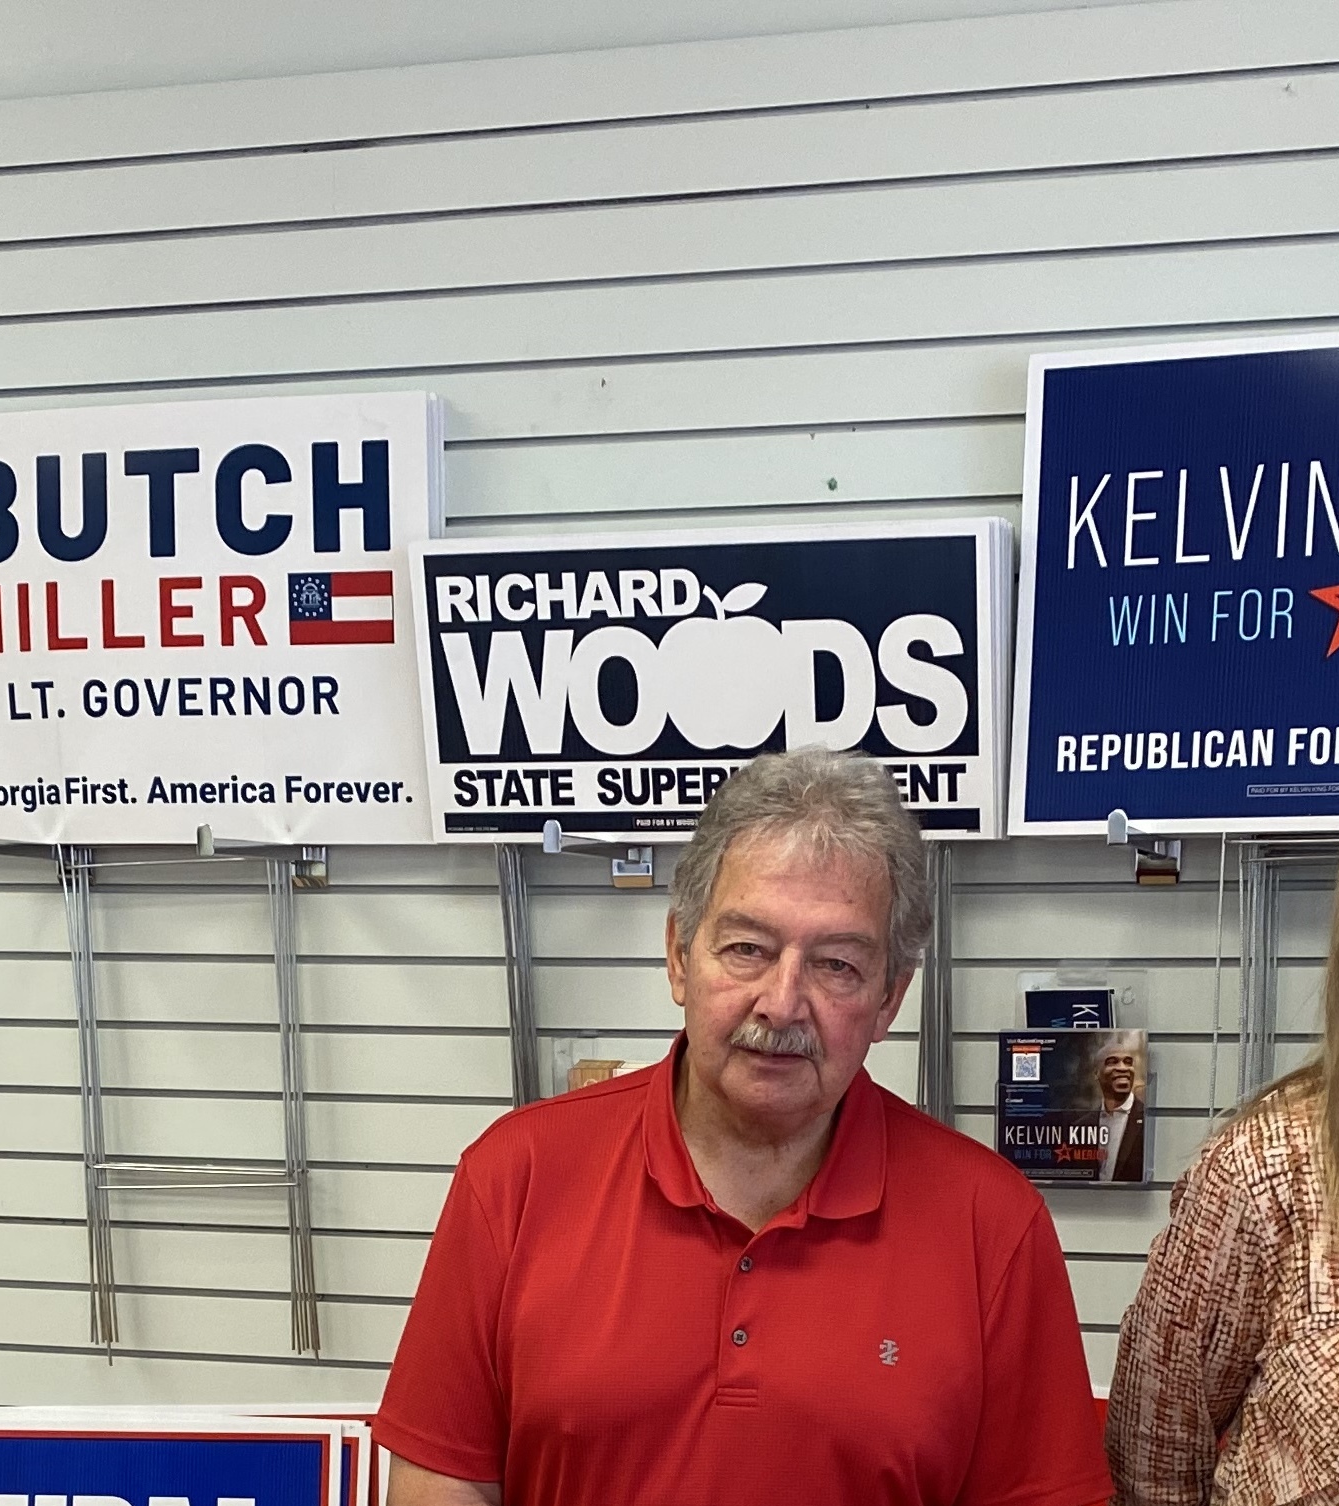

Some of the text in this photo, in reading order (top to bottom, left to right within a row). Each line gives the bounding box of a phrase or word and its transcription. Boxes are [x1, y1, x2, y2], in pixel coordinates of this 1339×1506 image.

[435, 567, 702, 623] RICHARD
[1109, 587, 1294, 647] WIN FOR
[7, 675, 341, 720] LT. GOVERNOR
[1057, 727, 1274, 773] REPUBLICAN
[64, 776, 138, 806] First.
[146, 775, 276, 805] America
[284, 774, 414, 804] Forever.
[453, 768, 575, 808] STATE
[1004, 1125, 1109, 1145] KELVIN KING
